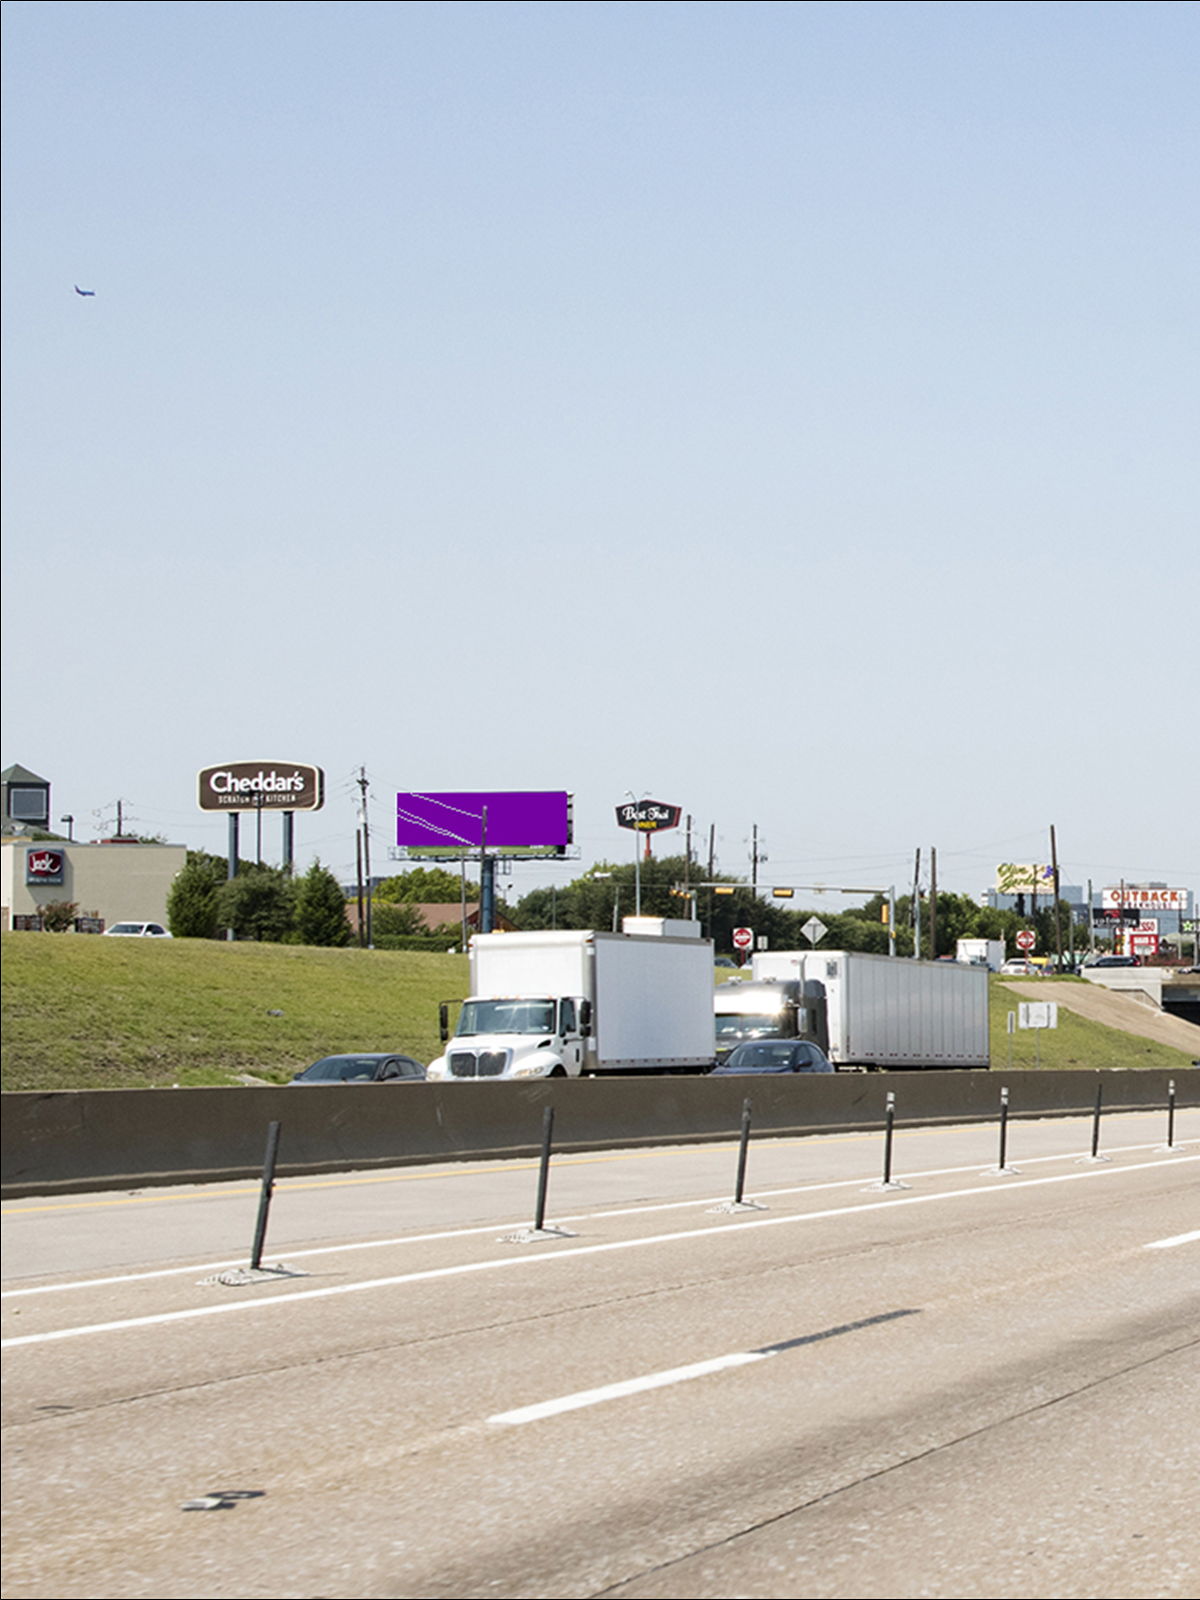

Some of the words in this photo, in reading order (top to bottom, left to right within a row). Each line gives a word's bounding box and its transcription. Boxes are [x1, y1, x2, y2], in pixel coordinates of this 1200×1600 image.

[209, 771, 304, 793] Cheddar's
[266, 794, 297, 803] KITCHEN
[29, 853, 61, 873] Jack
[997, 863, 1029, 877] Olive
[1110, 889, 1178, 902] OUTBACK
